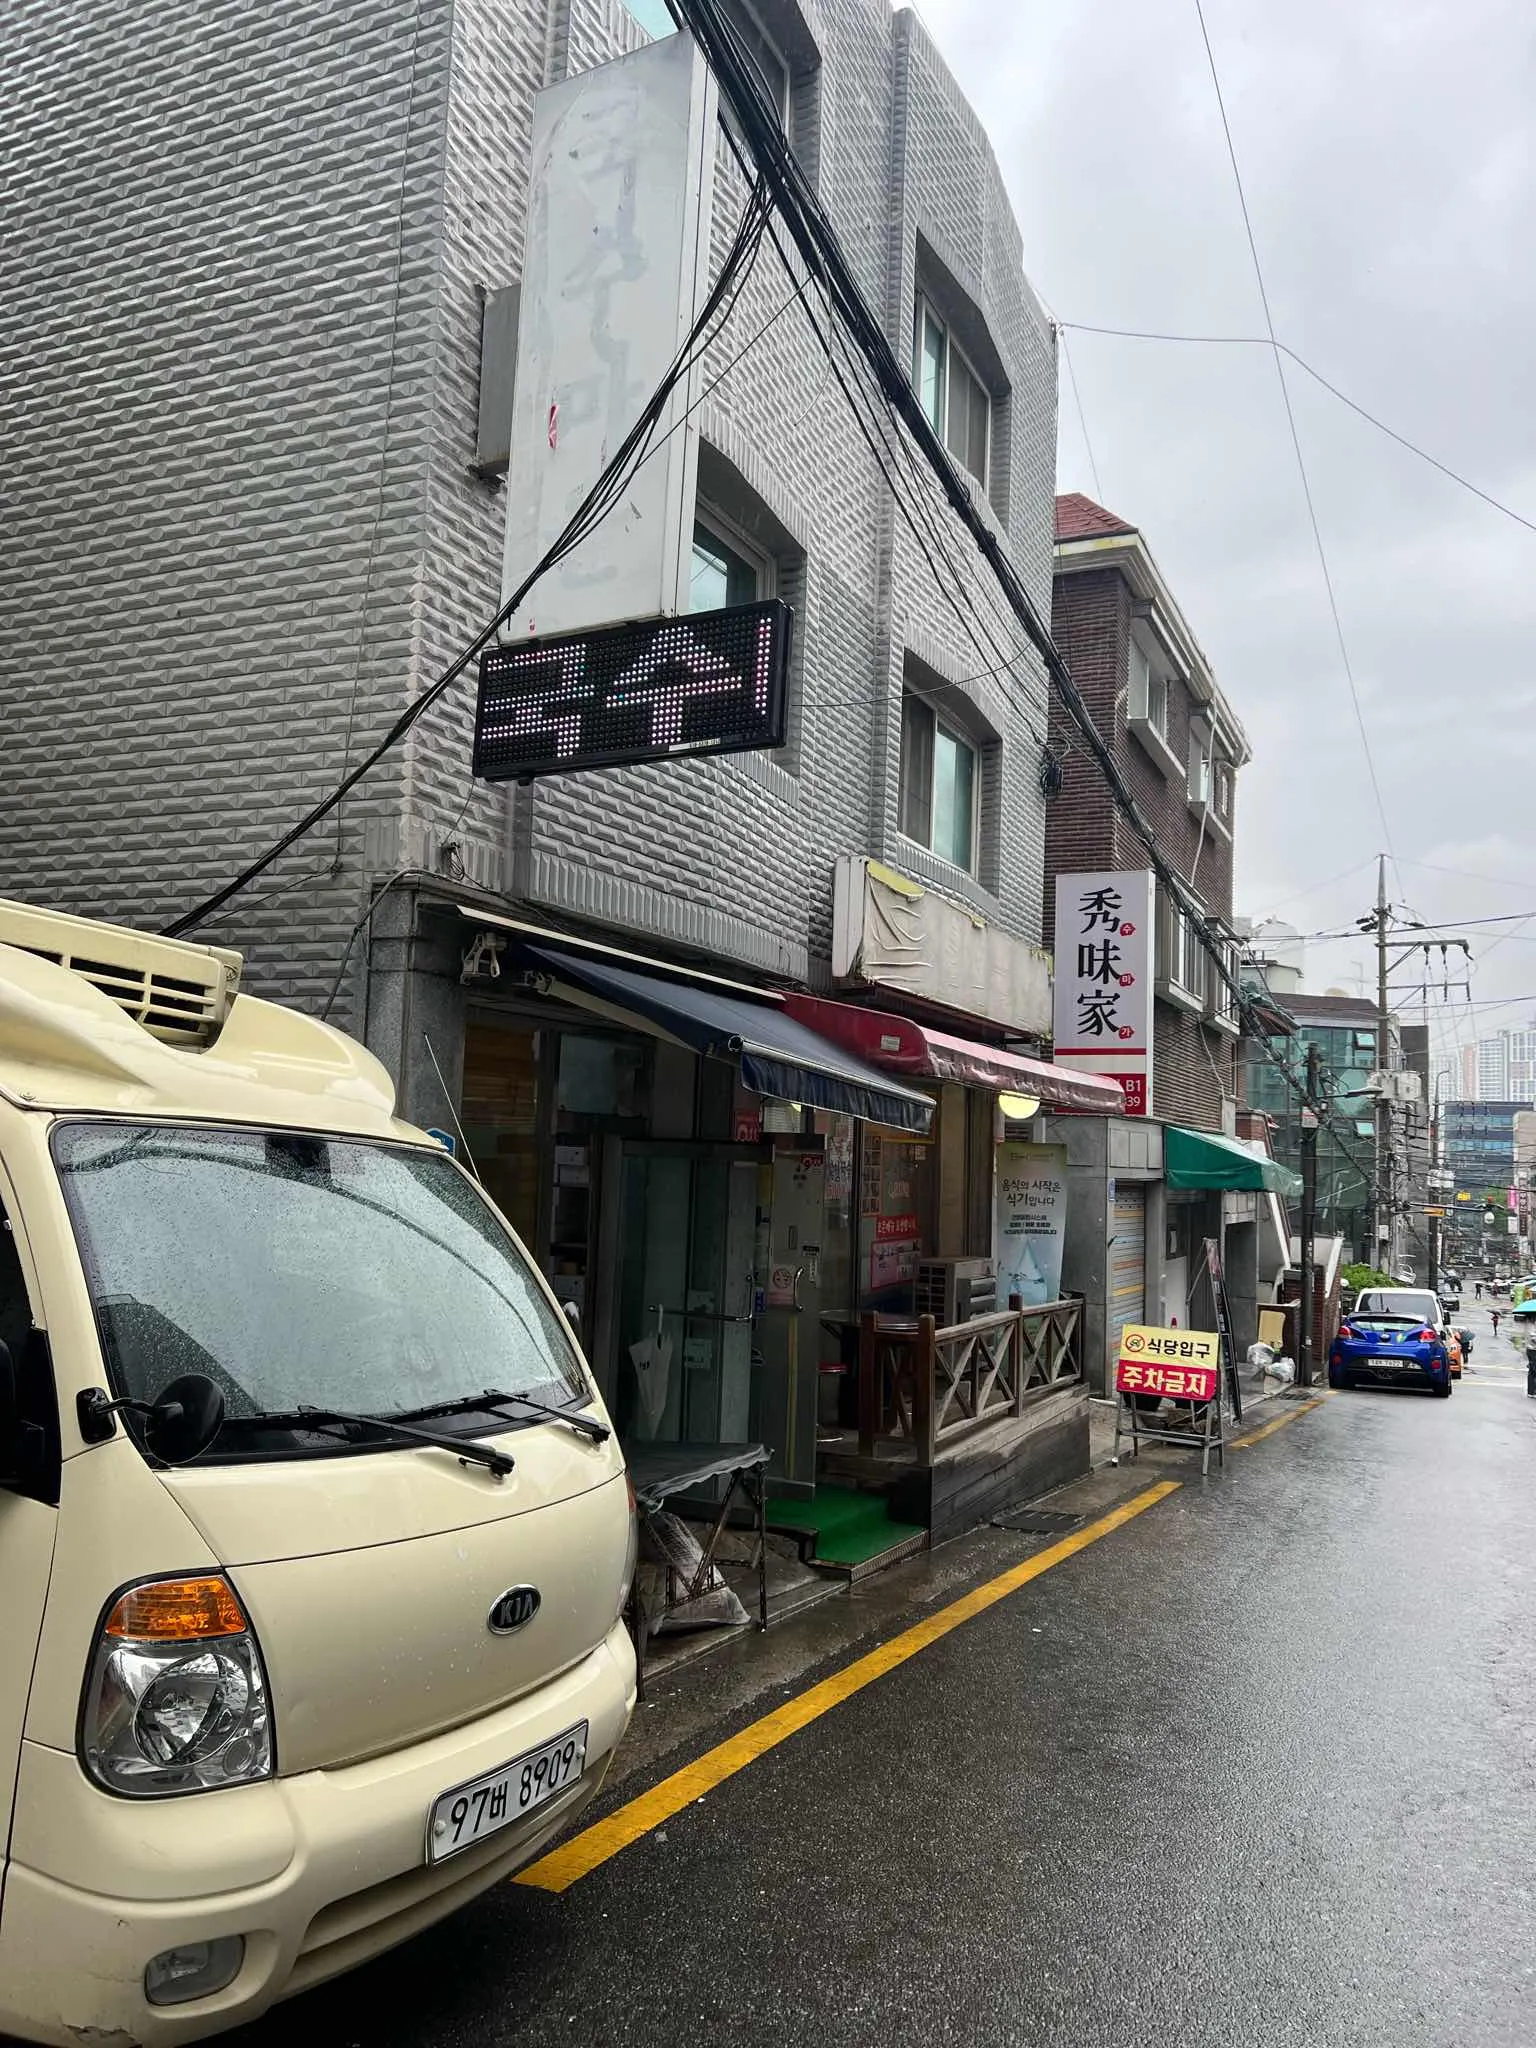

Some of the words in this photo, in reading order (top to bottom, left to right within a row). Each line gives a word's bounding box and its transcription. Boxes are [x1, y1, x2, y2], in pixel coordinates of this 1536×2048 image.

[482, 622, 744, 757] 국수
[1077, 886, 1123, 1037] 秀味家
[1006, 1193, 1056, 1208] 식기입니다
[1032, 1178, 1061, 1193] 시작은
[1147, 1339, 1210, 1358] 식당입구
[1123, 1366, 1207, 1396] 주차금지
[500, 1593, 535, 1626] KIA
[451, 1780, 509, 1844] 97버
[519, 1740, 576, 1808] 8909
